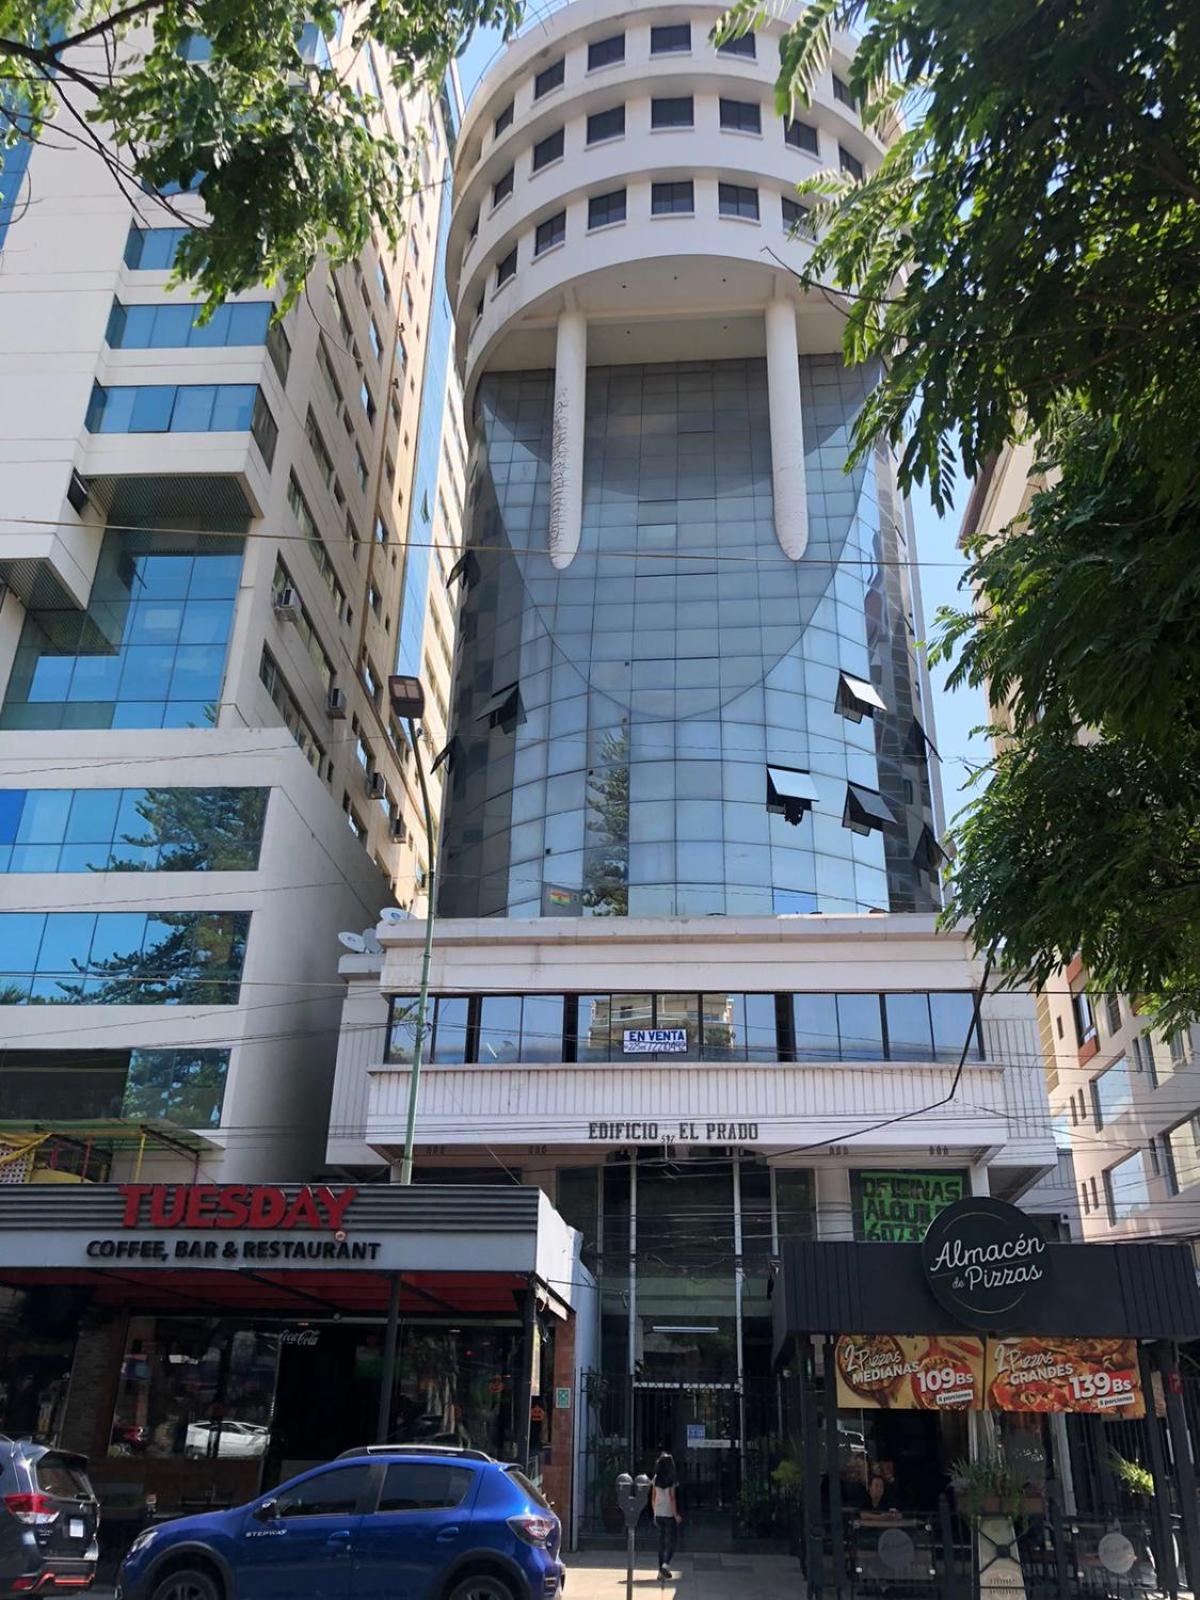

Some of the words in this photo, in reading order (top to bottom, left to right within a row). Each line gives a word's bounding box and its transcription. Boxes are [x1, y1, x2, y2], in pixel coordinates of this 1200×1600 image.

[629, 1031, 645, 1041] EN
[648, 1030, 684, 1041] VENTA
[588, 1122, 658, 1140] EDIFICIO
[678, 1122, 699, 1140] EL
[706, 1122, 758, 1140] PRADO
[863, 1178, 961, 1203] OFICINAS
[118, 1184, 359, 1230] TUESDAY
[87, 1240, 169, 1262] COFFEE,
[175, 1241, 218, 1259] BAR
[222, 1241, 238, 1259] &
[243, 1241, 381, 1261] RESTAURANT
[930, 1233, 1045, 1272] Almacén
[952, 1276, 965, 1289] de
[965, 1265, 1043, 1291] Pizzas
[844, 1344, 858, 1372] 2
[994, 1343, 1009, 1374] 2
[852, 1361, 920, 1385] MEDIANAS
[1010, 1362, 1074, 1386] GRANDES
